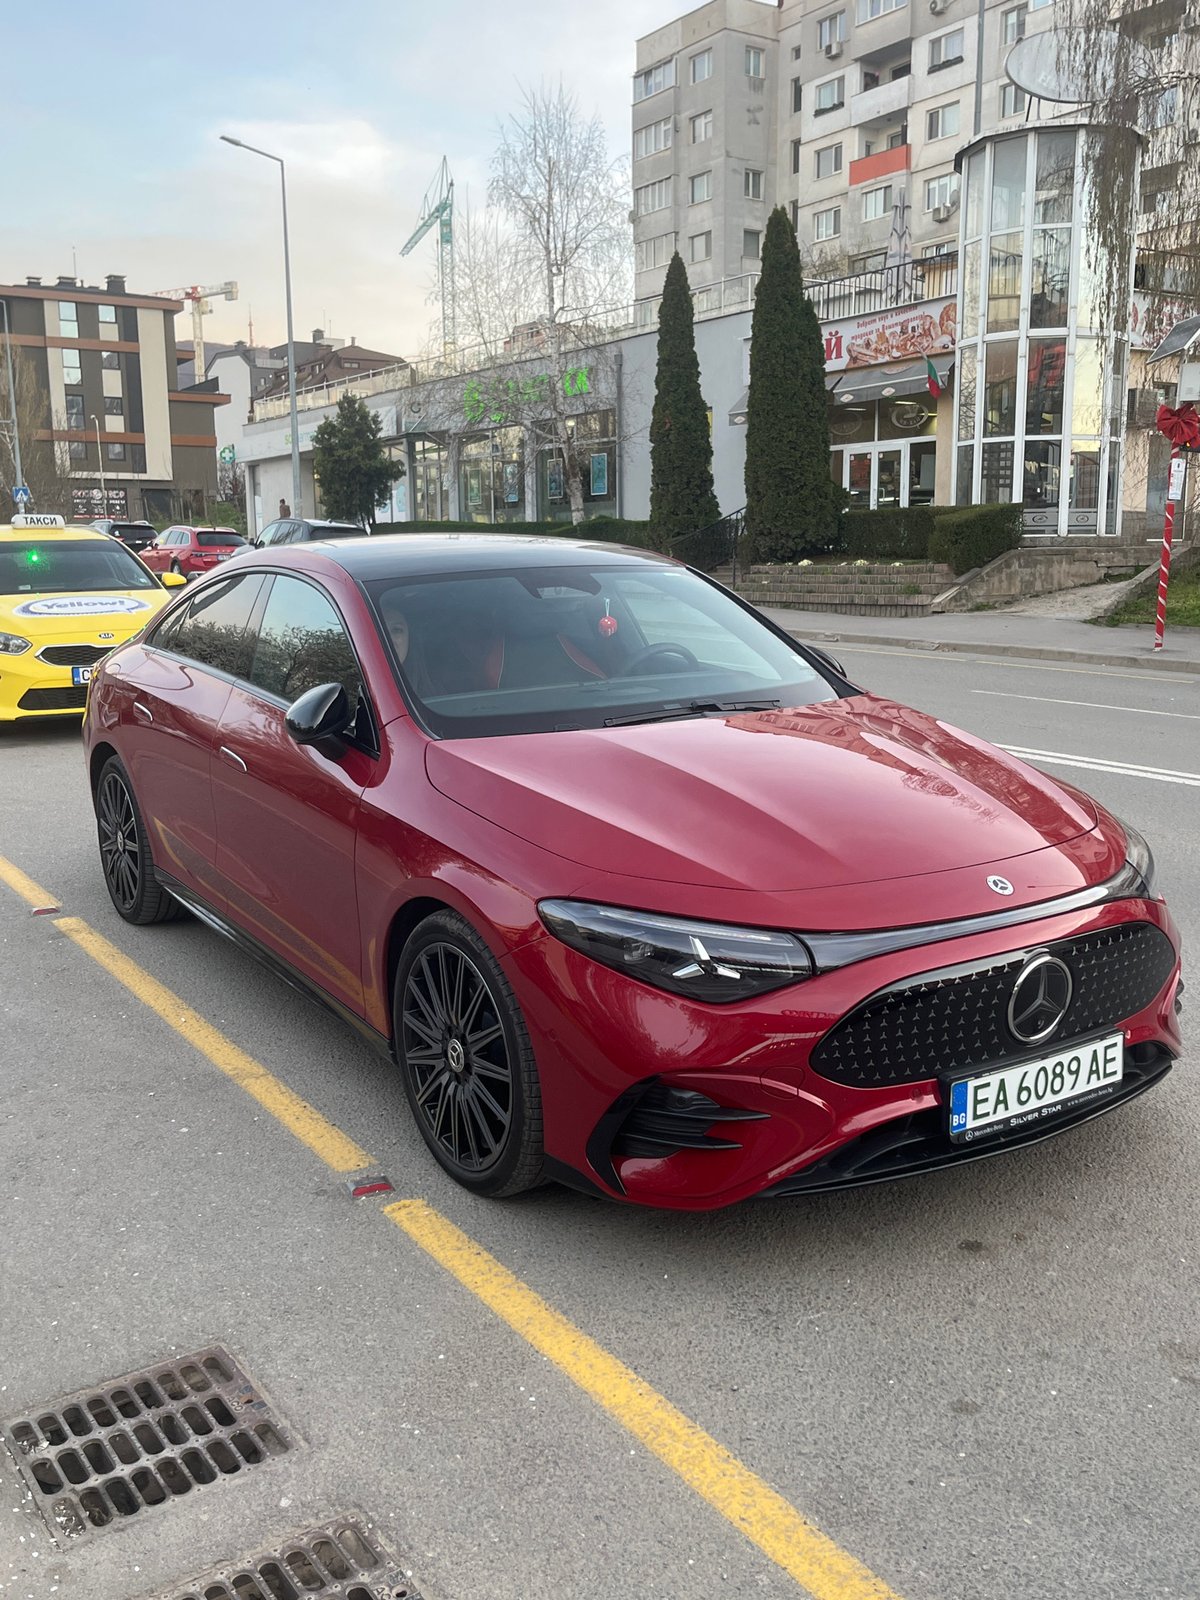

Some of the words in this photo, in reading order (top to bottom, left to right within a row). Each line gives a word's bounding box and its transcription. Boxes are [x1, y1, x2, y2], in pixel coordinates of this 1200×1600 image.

[23, 516, 57, 526] ТАКСИ
[41, 600, 125, 610] Yellow!
[972, 1078, 1009, 1121] EA
[1016, 1055, 1081, 1106] 6089
[1087, 1042, 1118, 1085] AE
[953, 1112, 966, 1126] BG
[1009, 1111, 1039, 1127] SILVER
[1041, 1104, 1062, 1117] STAR
